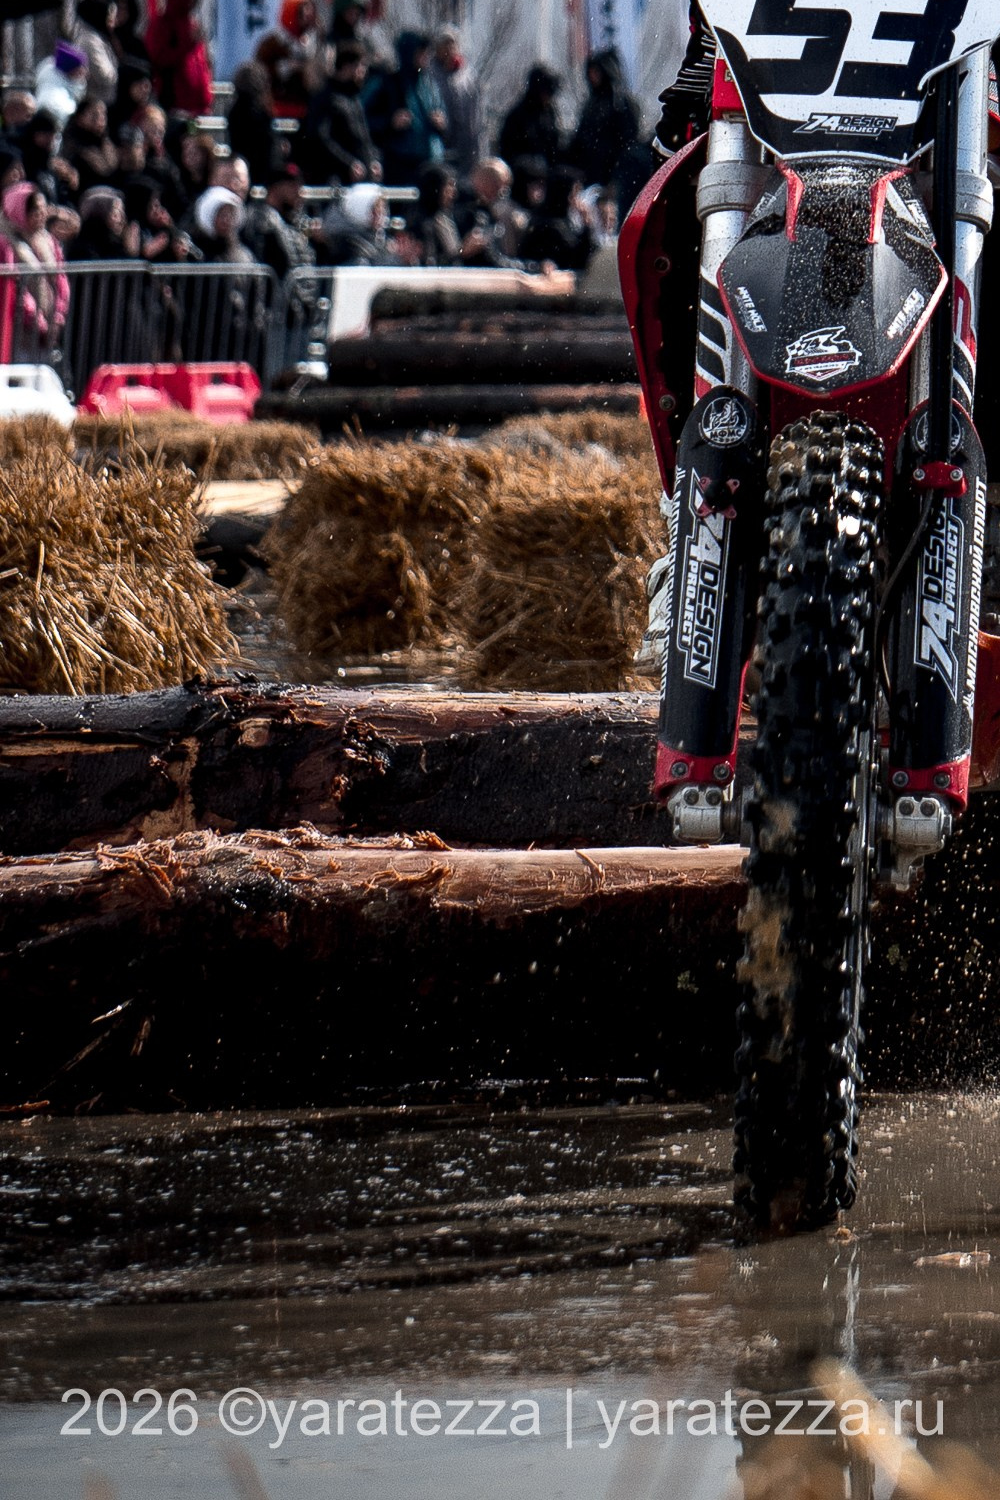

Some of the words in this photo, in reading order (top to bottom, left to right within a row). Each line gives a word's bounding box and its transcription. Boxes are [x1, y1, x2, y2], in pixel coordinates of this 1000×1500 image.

[804, 114, 841, 131] 74
[840, 115, 893, 129] DESIGN
[837, 125, 878, 134] PROJECT
[974, 476, 987, 545] СПОРТ
[681, 560, 698, 647] PROJECT
[944, 520, 959, 608] PROJECT
[690, 563, 721, 680] DESIGN
[921, 598, 956, 690] 74
[966, 544, 984, 694] МОСКОВСКИЙ
